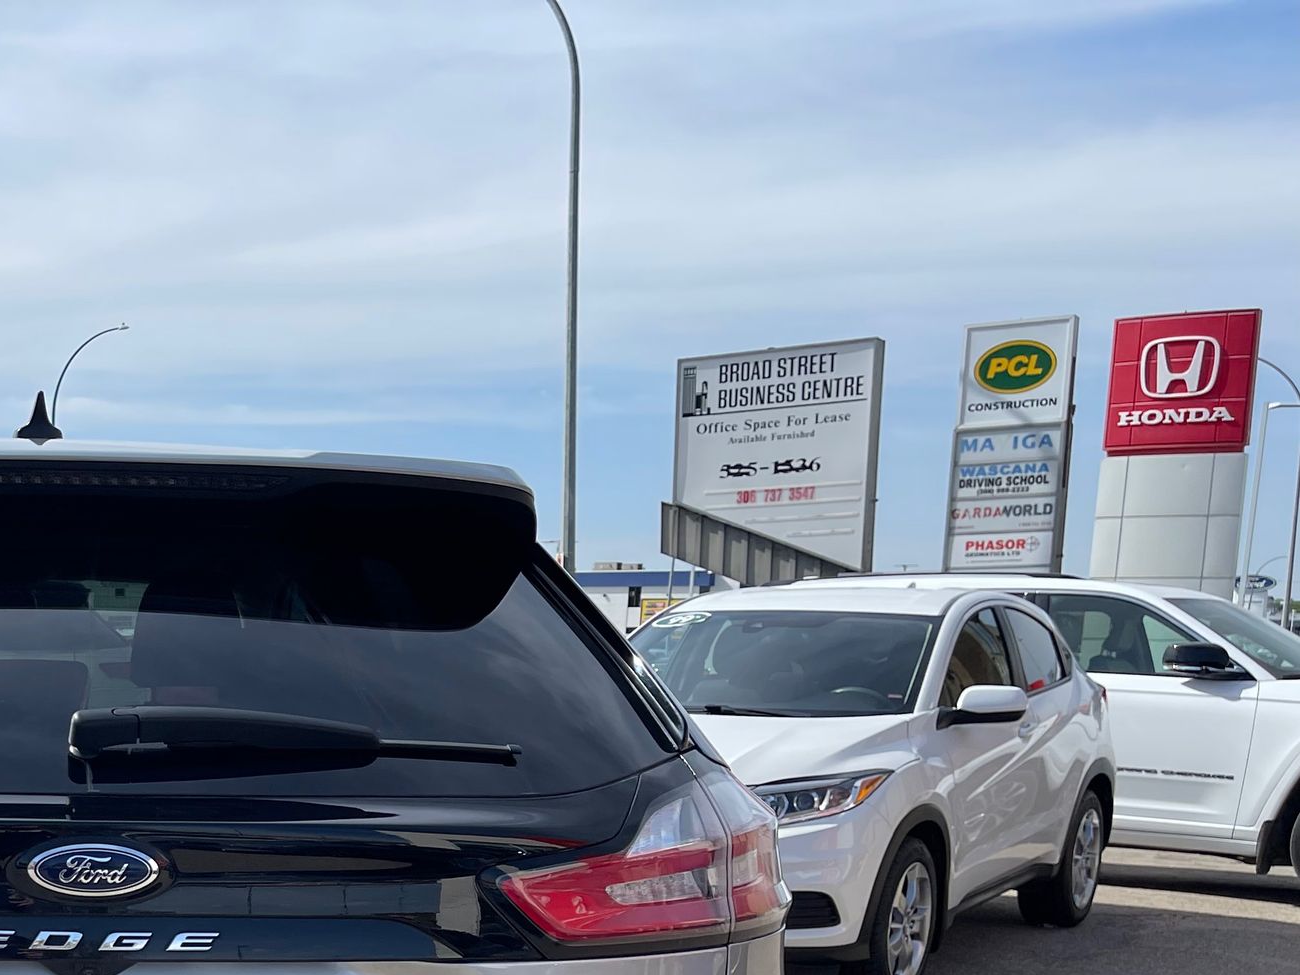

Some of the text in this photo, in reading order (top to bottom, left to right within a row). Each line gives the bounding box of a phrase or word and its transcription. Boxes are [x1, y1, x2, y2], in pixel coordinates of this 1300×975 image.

[719, 352, 838, 384] BROAD STREET
[986, 354, 1043, 379] PCL
[718, 375, 865, 409] BUSINESS CENTRE
[967, 397, 1058, 413] CONSTRUCTION
[696, 412, 852, 435] Office Space For Lease
[1117, 406, 1235, 427] HONDA
[727, 430, 816, 446] Available Furnished
[960, 463, 1050, 478] WASCANA
[958, 474, 1050, 489] DRIVING SCHOOL
[736, 486, 817, 505] 306 737 3547
[965, 538, 1027, 552] PHASOR
[58, 854, 129, 885] Ford
